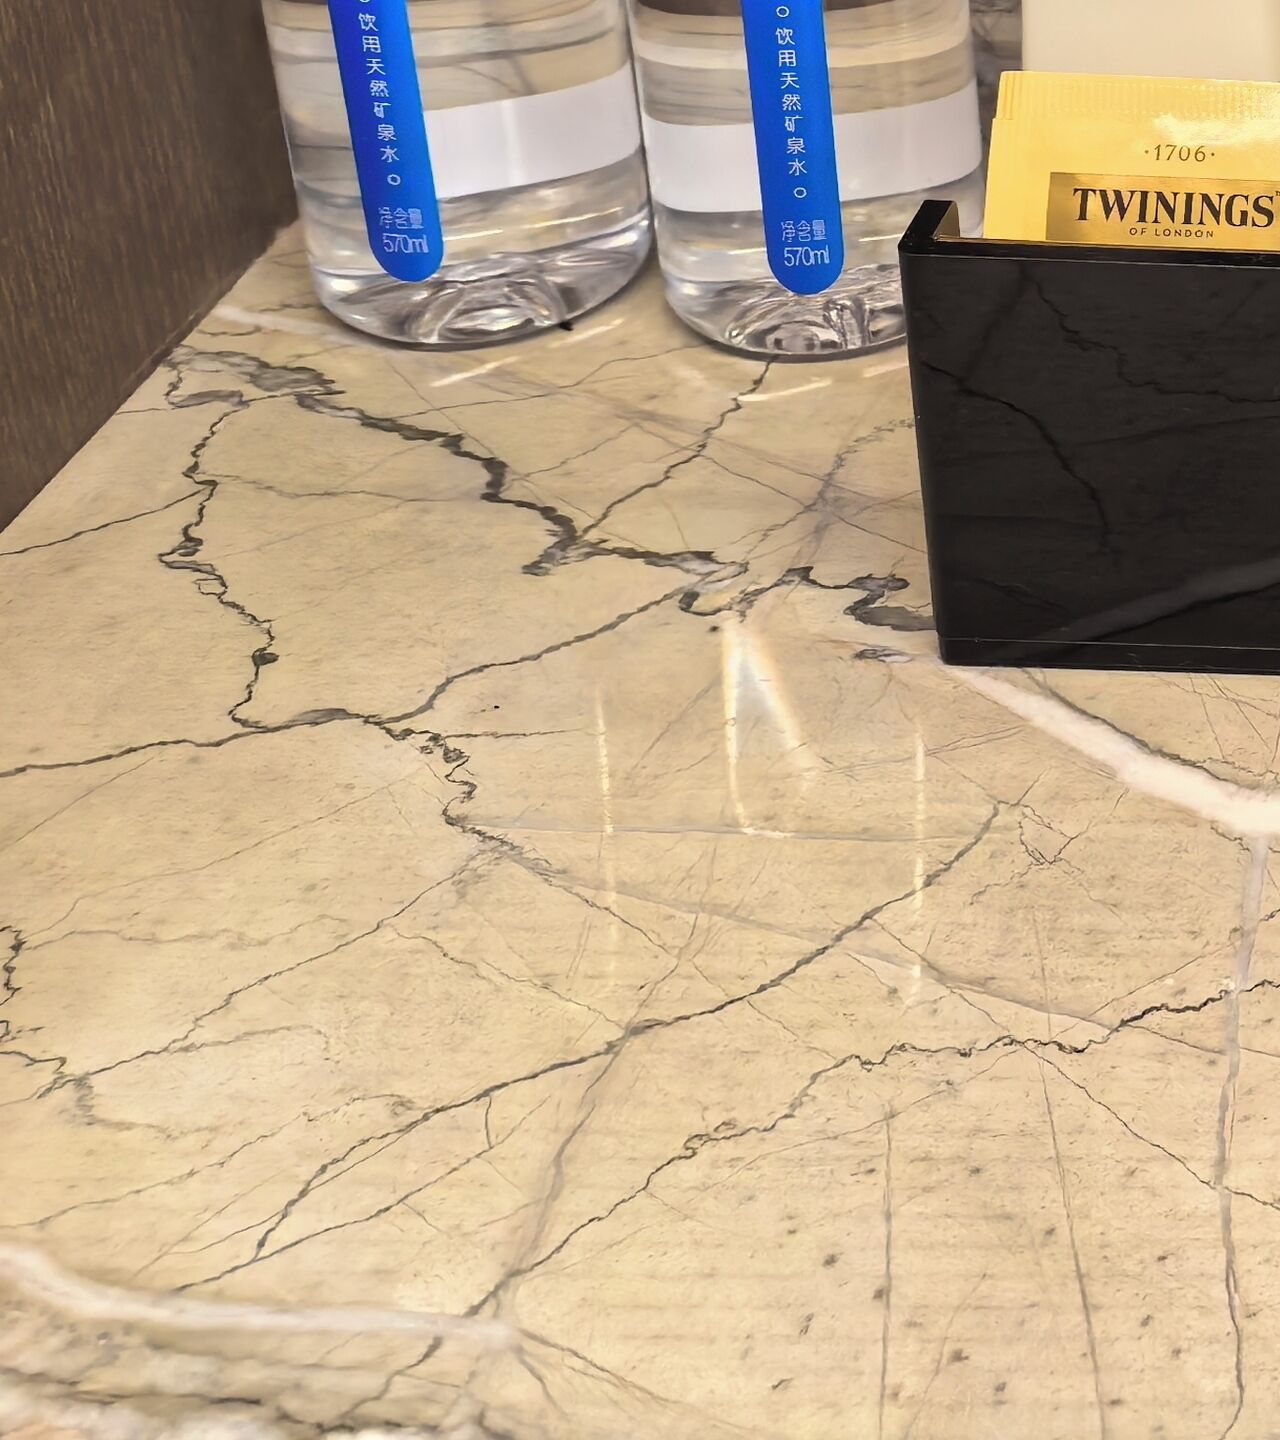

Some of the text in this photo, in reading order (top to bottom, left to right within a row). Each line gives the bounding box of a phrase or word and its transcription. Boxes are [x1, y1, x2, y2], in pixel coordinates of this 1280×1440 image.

[358, 12, 400, 163] 饮用天然矿泉水
[775, 27, 808, 175] 饮用天然矿泉水
[1153, 143, 1207, 162] 1706
[381, 233, 430, 255] 570ml
[1129, 227, 1214, 239] OF LONDON
[783, 243, 831, 267] 570ml
